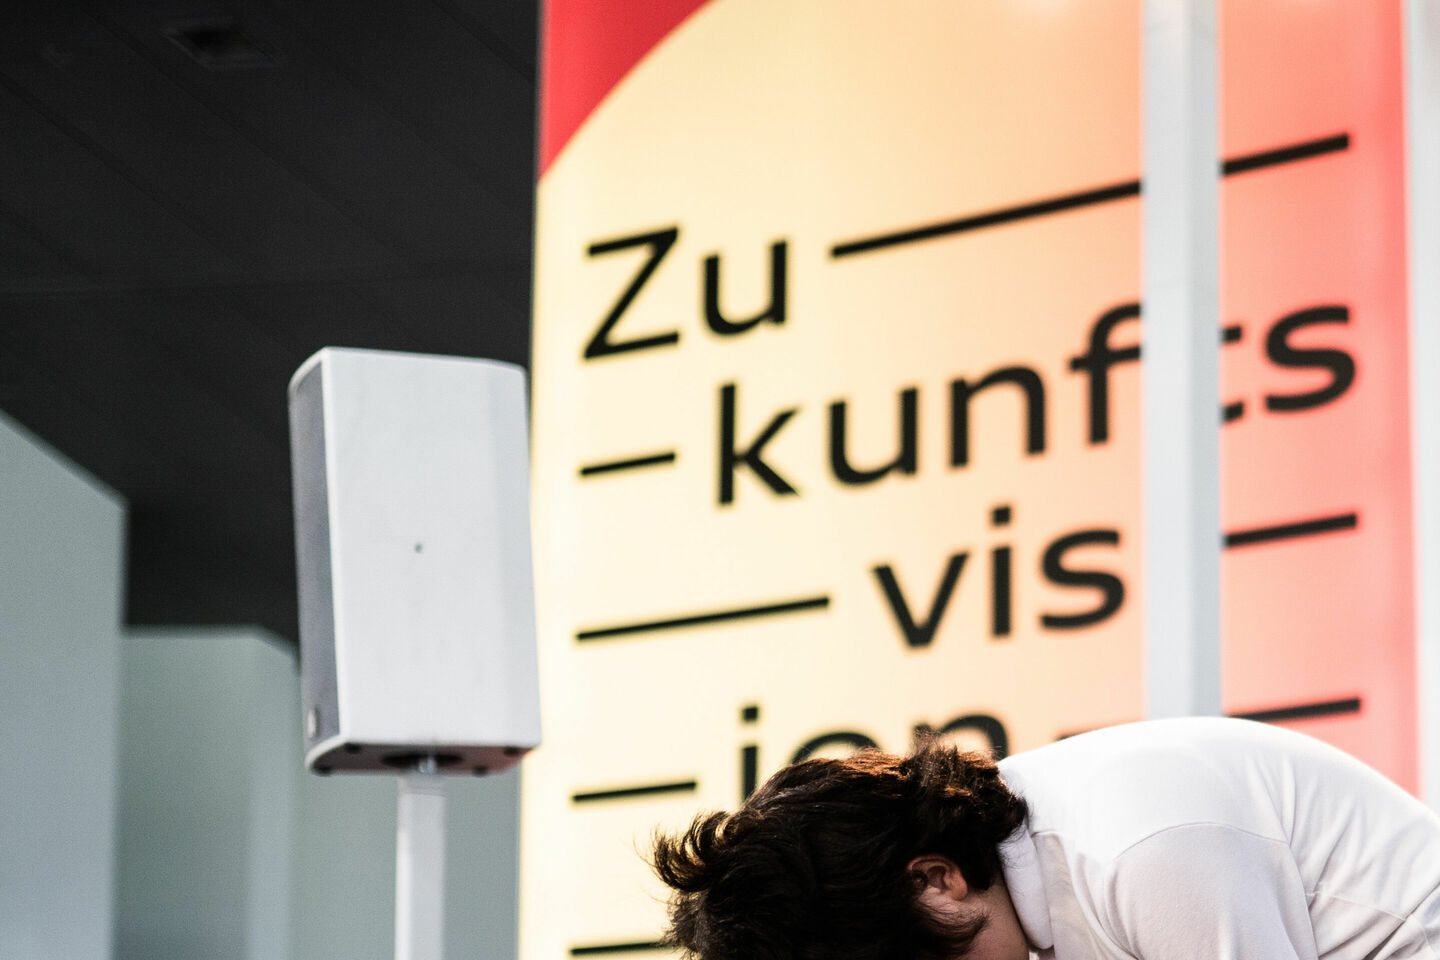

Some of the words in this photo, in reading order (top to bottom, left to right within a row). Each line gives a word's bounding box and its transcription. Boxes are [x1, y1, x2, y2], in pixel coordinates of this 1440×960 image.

[583, 226, 790, 360] Zu
[715, 301, 1357, 507] kunfs
[872, 505, 1126, 648] vis
